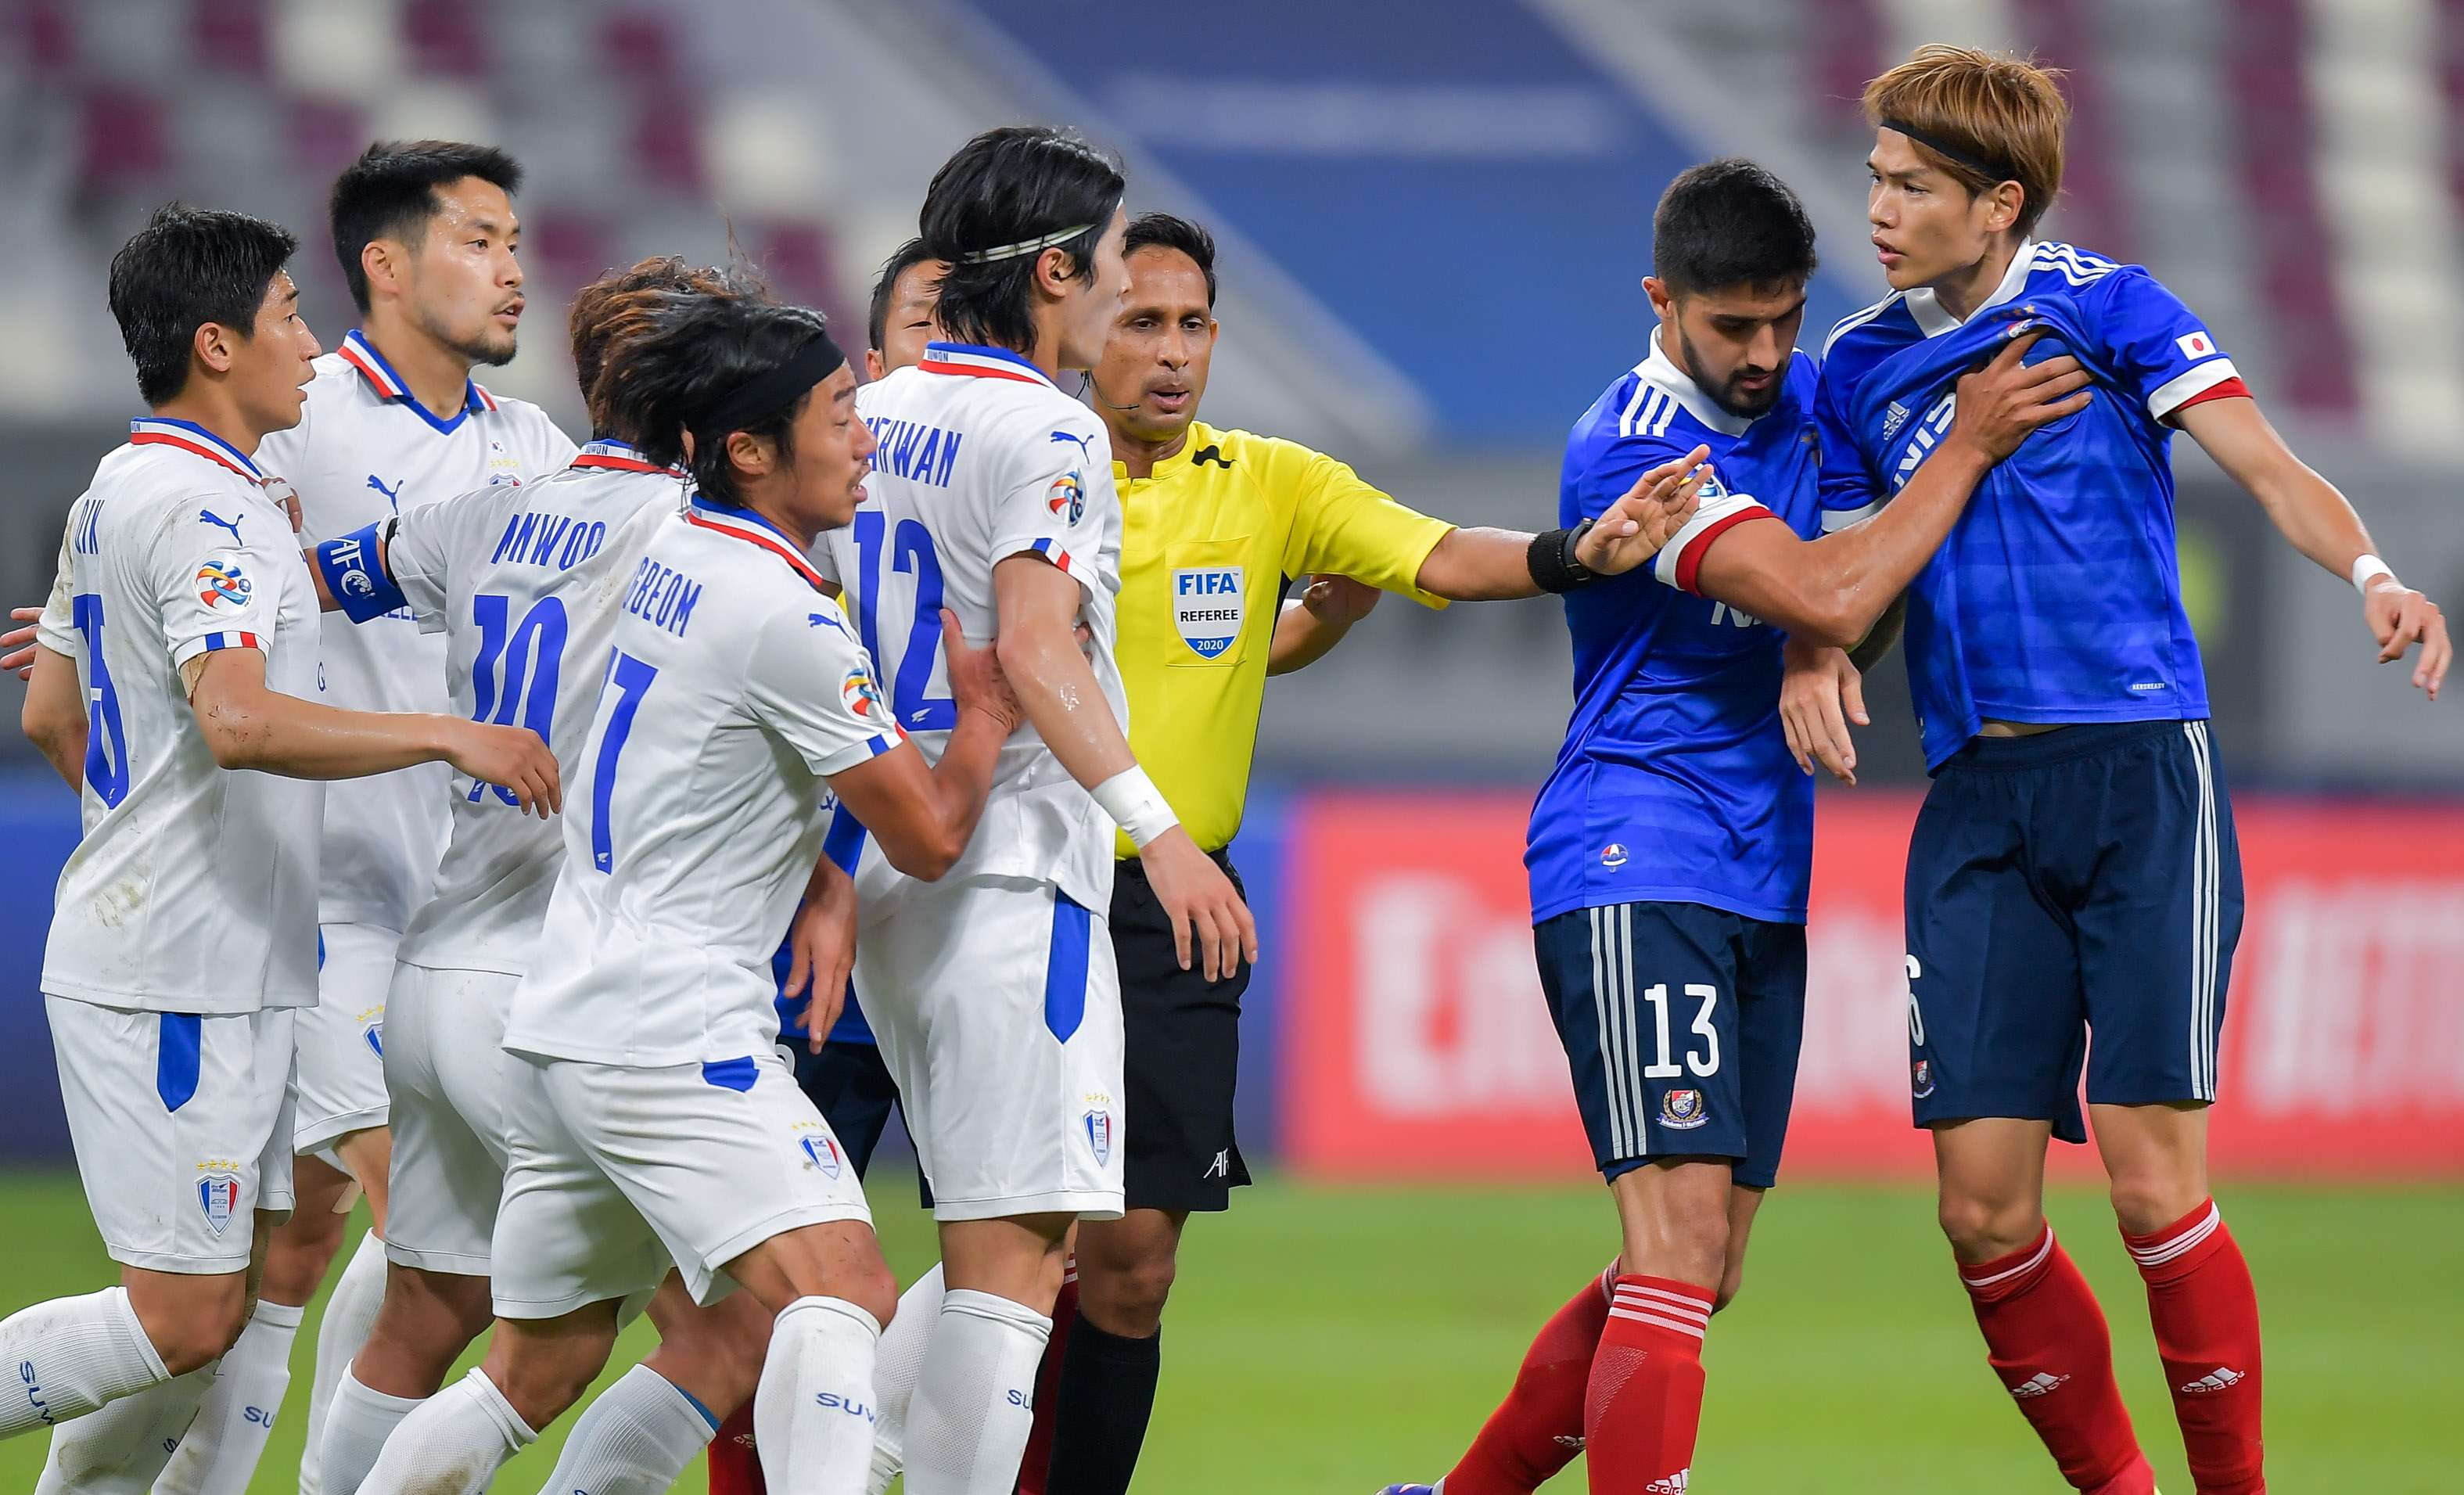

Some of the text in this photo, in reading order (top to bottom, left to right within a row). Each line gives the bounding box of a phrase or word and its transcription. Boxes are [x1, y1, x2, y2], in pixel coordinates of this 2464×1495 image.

[853, 511, 957, 732] 12
[1180, 609, 1239, 623] REFEREE
[1197, 640, 1224, 652] 2020
[467, 595, 569, 807] 10
[592, 643, 659, 876] 7
[1644, 983, 1720, 1078] 13
[2181, 1370, 2246, 1393] adidas
